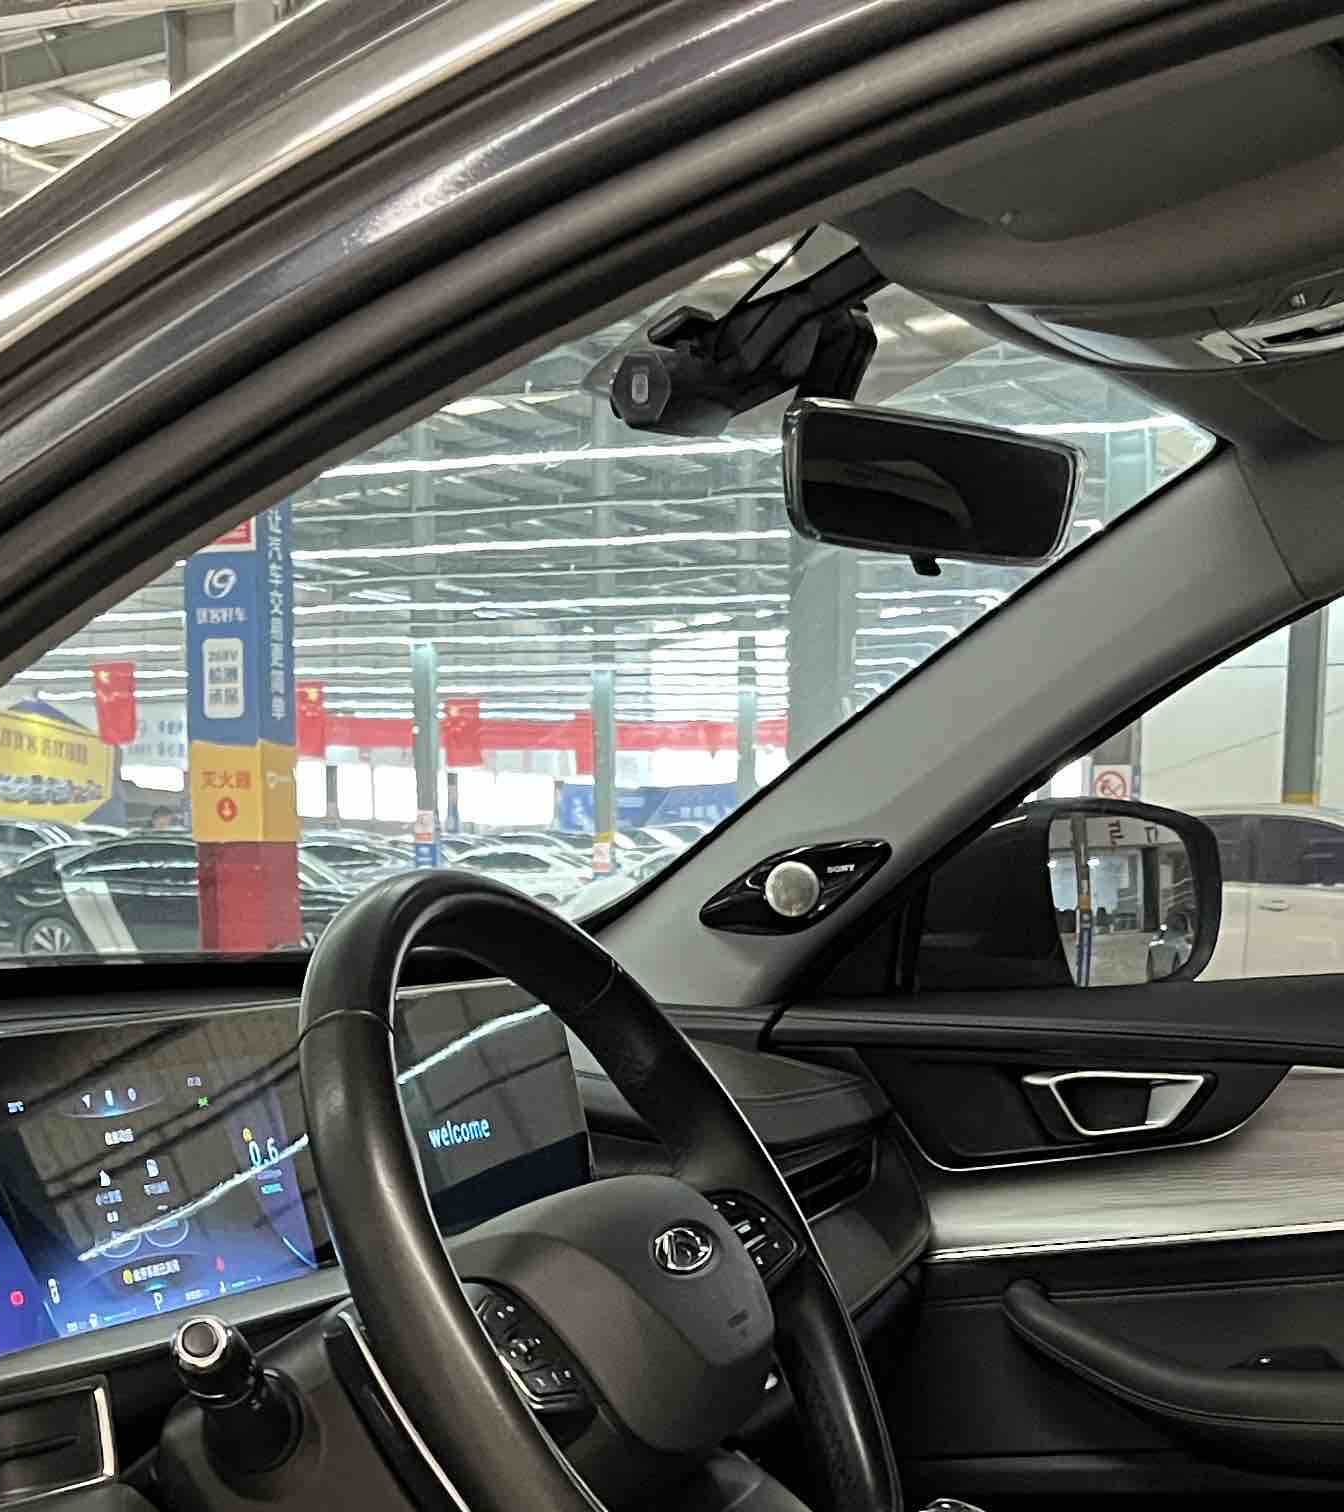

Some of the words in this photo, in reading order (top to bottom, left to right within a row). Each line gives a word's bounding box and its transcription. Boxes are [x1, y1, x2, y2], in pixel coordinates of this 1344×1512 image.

[827, 864, 855, 873] SONY
[428, 1119, 491, 1148] welcome
[249, 1137, 280, 1168] 0.6
[154, 1292, 163, 1310] P
